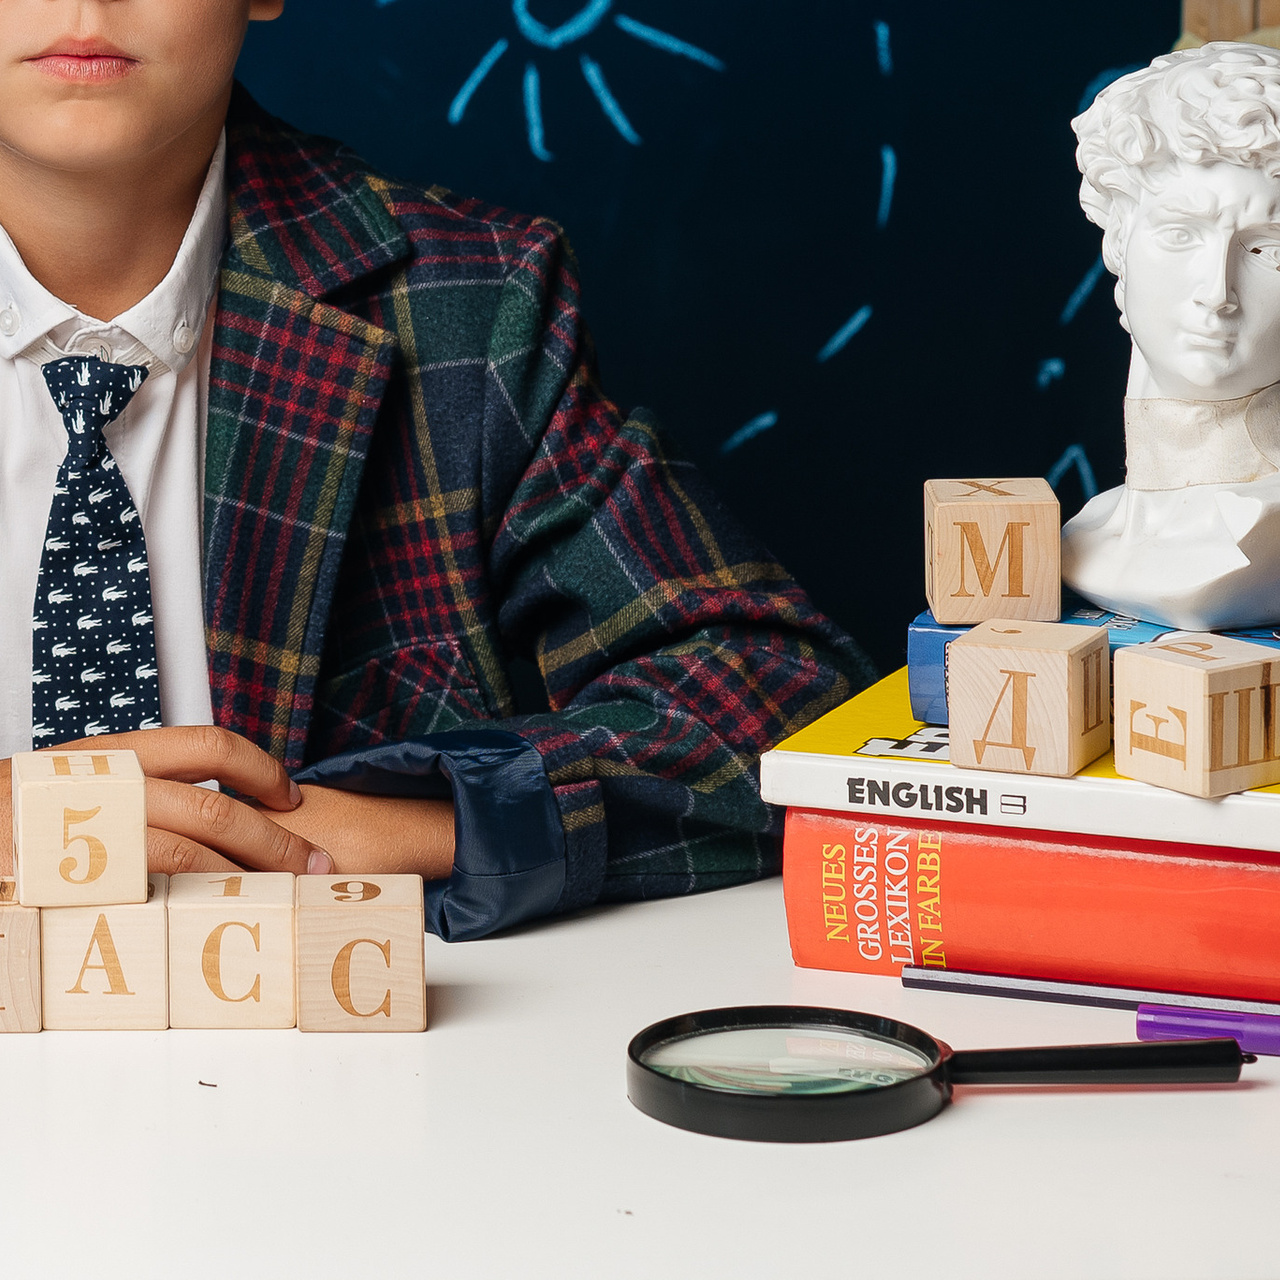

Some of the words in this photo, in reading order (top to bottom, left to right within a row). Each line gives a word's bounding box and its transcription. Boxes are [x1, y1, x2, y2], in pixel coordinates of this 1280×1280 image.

[950, 522, 1030, 598] М
[973, 669, 1037, 771] Д
[846, 777, 988, 815] ENGLISH
[58, 805, 108, 885] 5
[207, 876, 249, 898] 1
[916, 830, 942, 932] FARBE
[822, 844, 850, 943] NEUES
[853, 827, 883, 961] GROSSES
[884, 827, 915, 965] LEXIKON
[920, 936, 947, 968] IN
